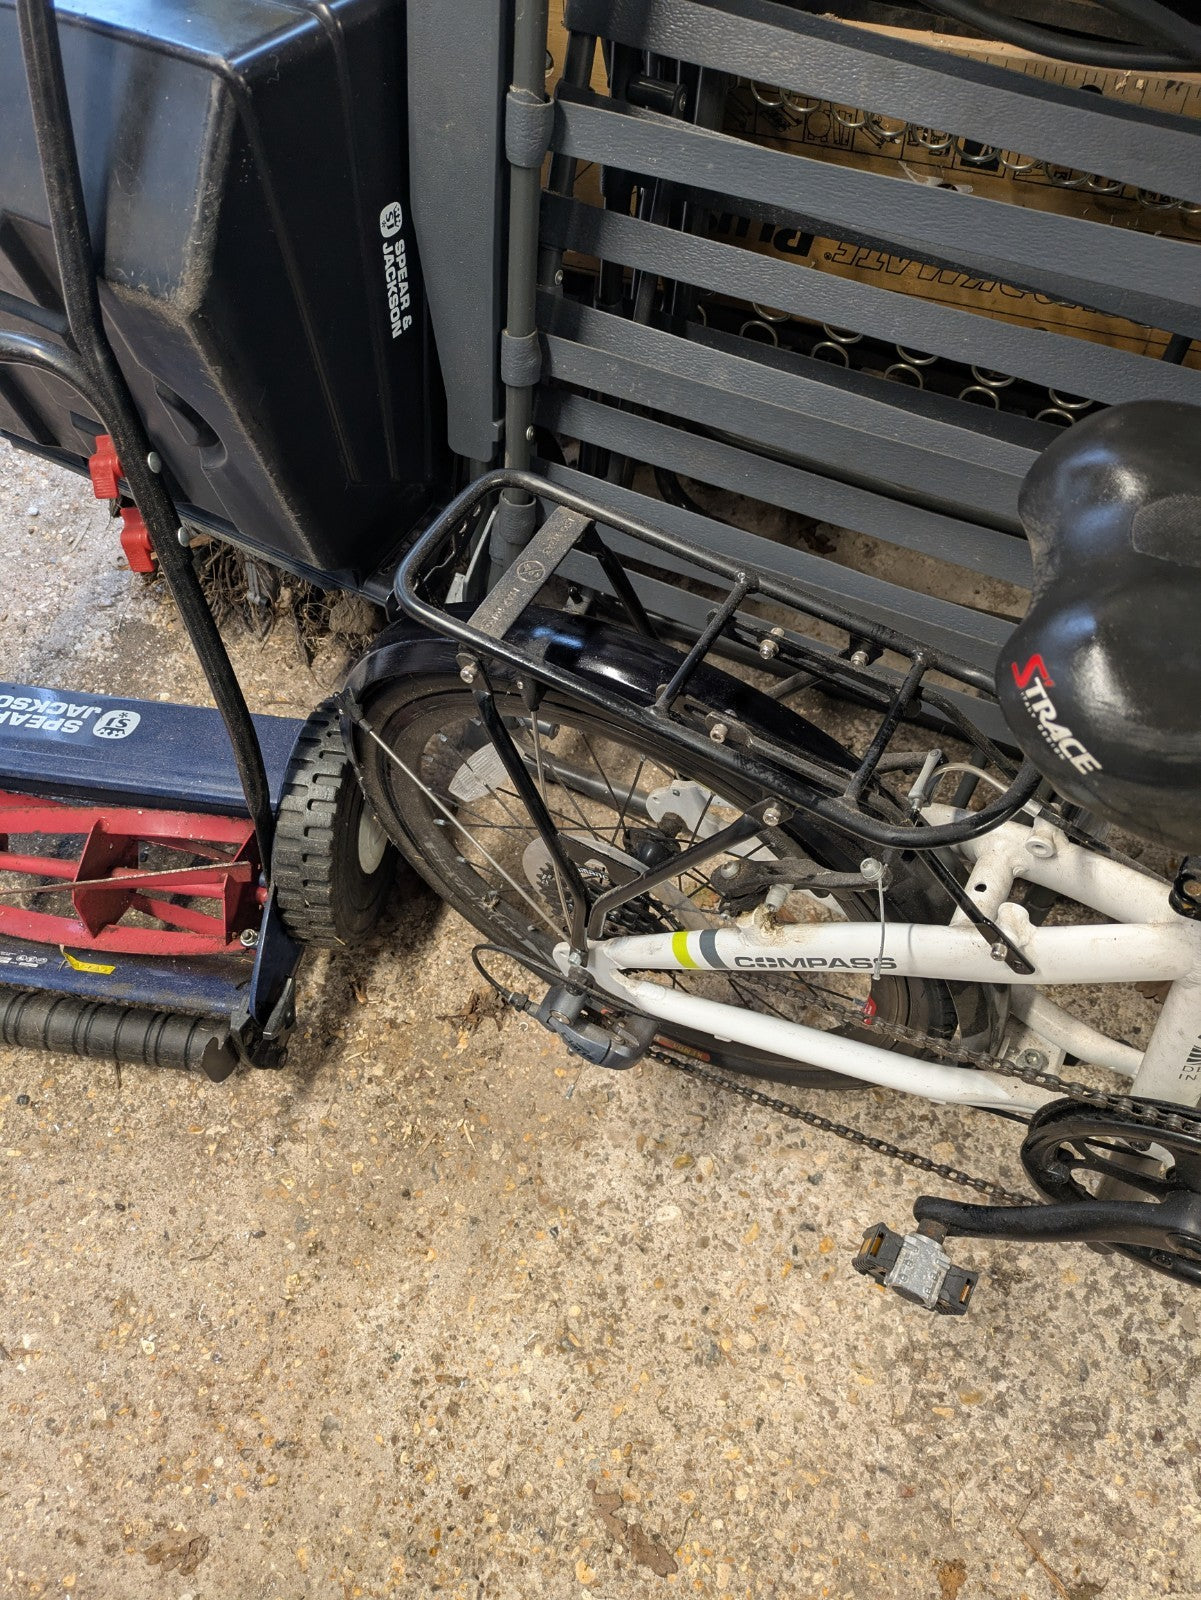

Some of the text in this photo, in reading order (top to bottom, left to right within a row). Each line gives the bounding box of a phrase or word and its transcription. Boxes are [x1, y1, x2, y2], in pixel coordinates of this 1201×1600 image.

[382, 241, 403, 339] JACKSON
[394, 238, 413, 332] SPEAR &
[1011, 653, 1103, 776] STRACE
[734, 956, 897, 969] COMPASS
